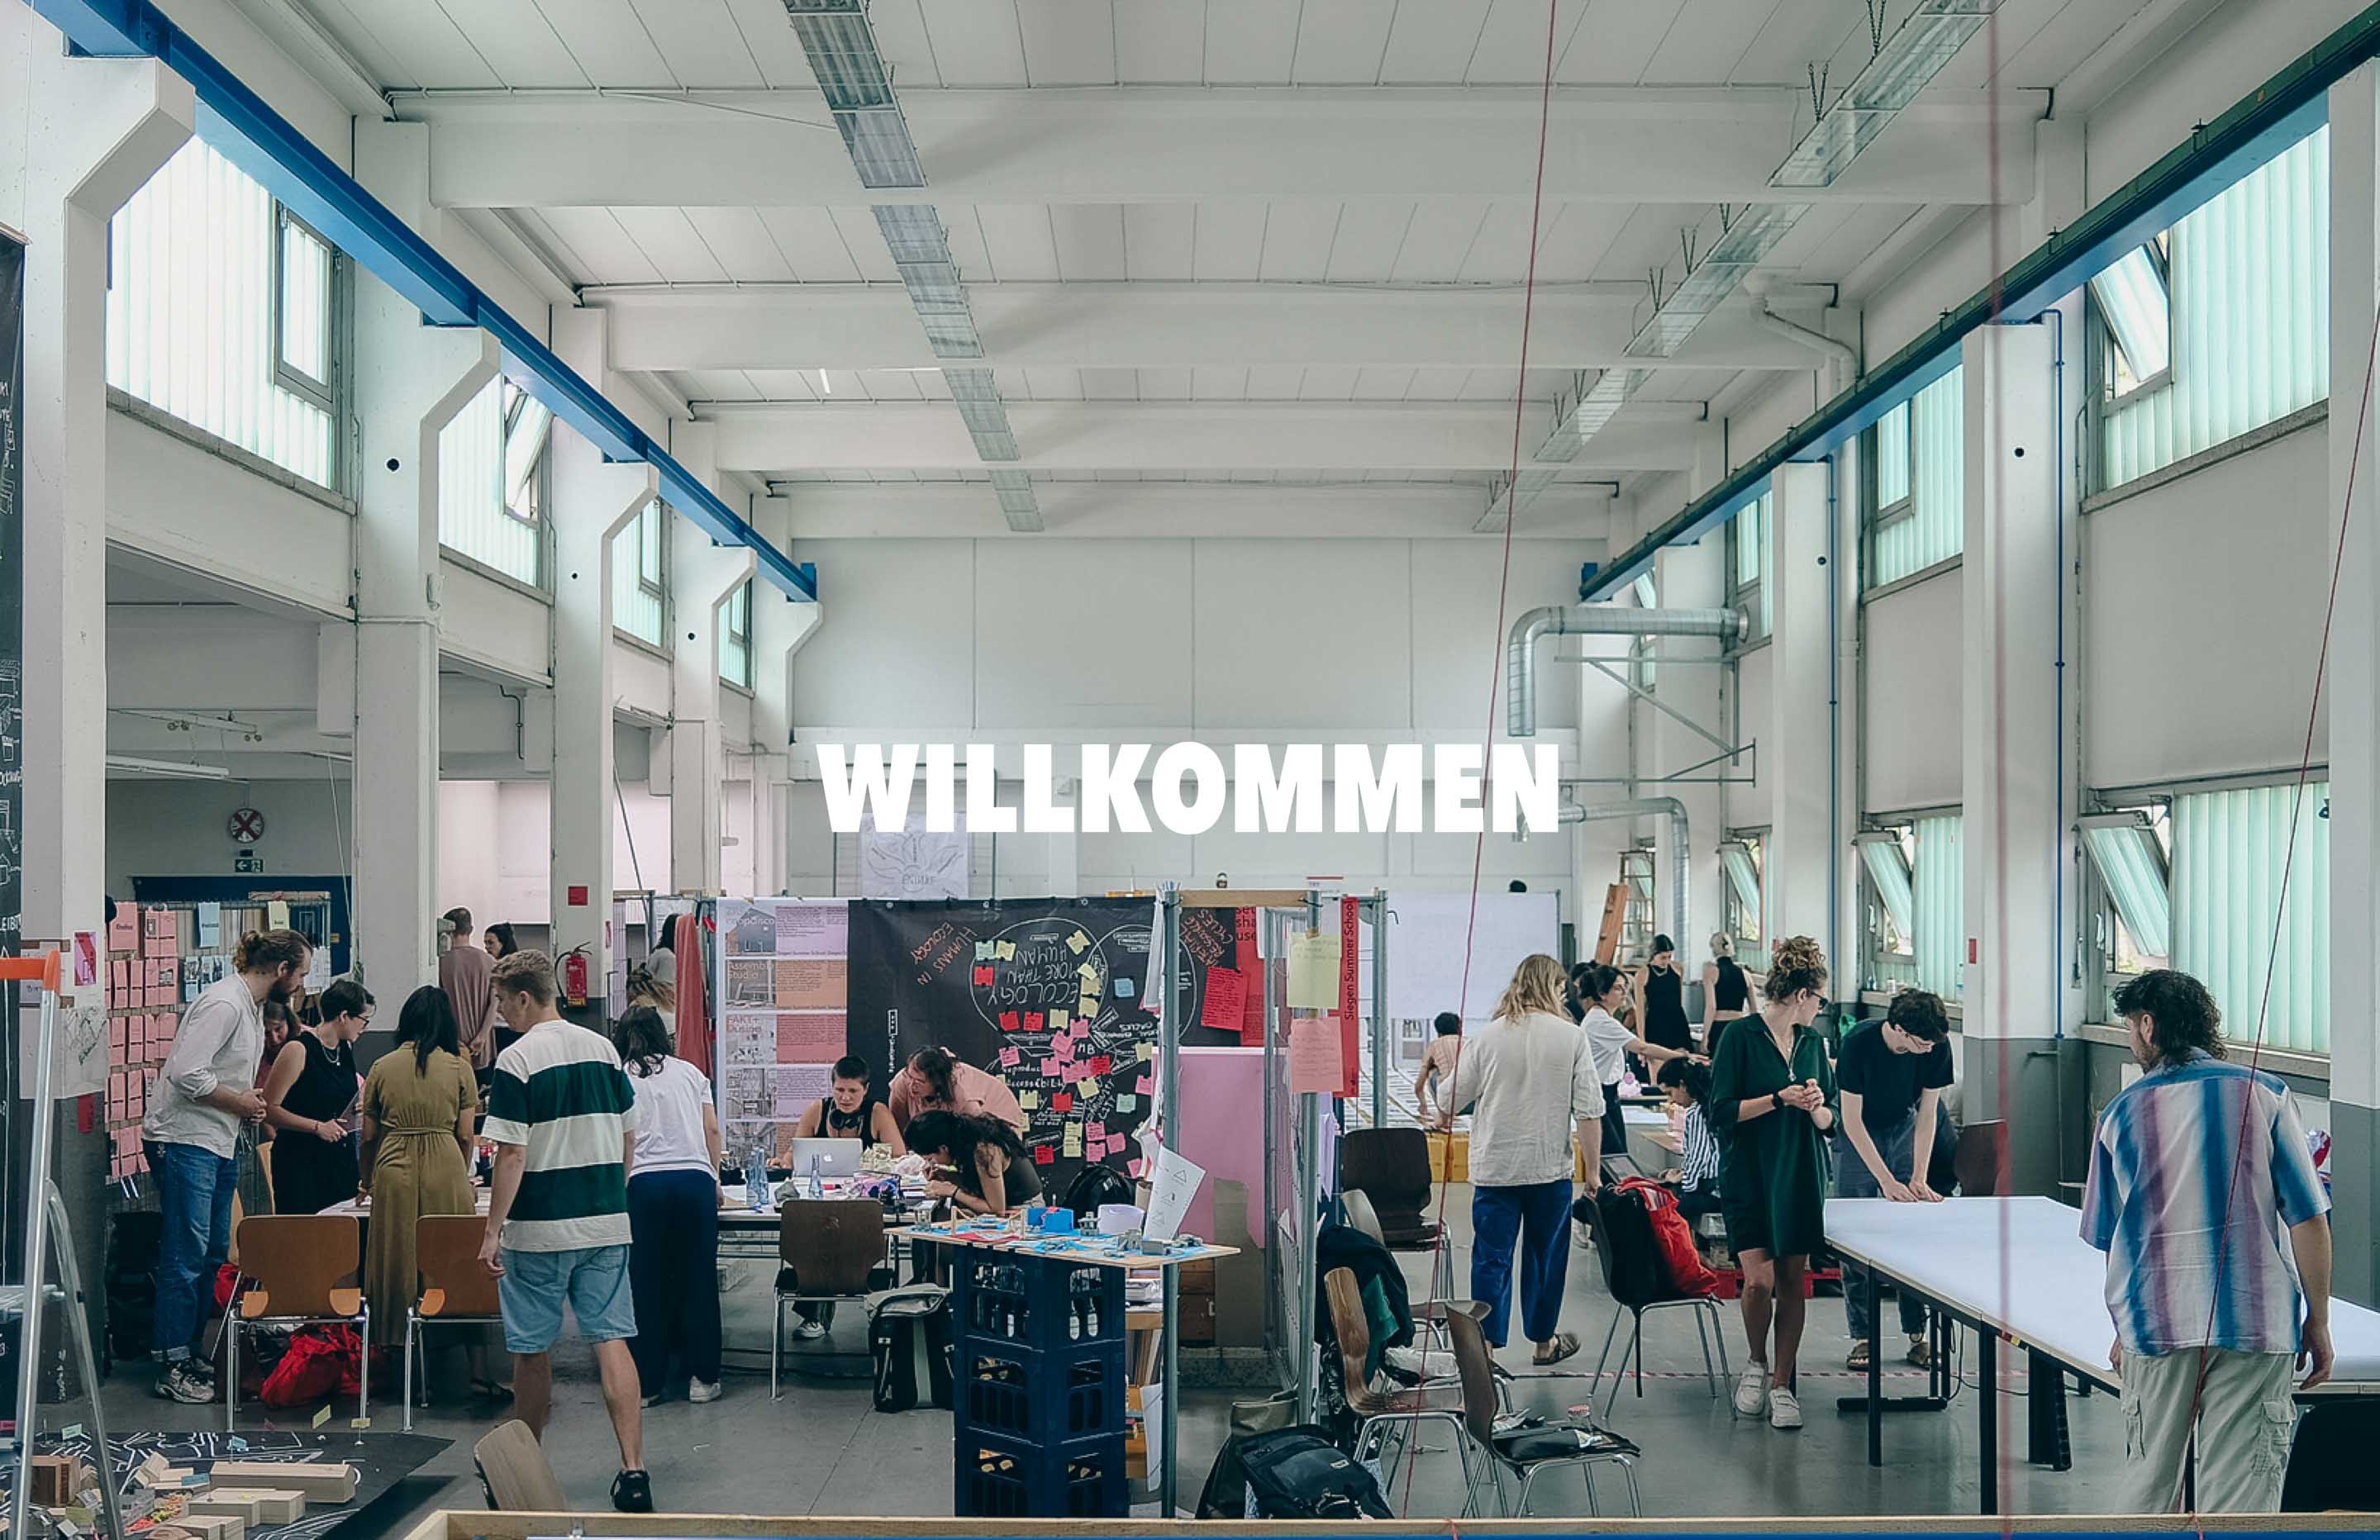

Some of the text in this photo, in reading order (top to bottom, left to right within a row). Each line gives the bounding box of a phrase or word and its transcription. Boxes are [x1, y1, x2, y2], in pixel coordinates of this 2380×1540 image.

[911, 921, 954, 964] ECOLOGY
[917, 926, 978, 985] HUMANS IN
[1016, 946, 1067, 965] HUMAN
[1007, 962, 1080, 984] MORE THAN
[1344, 900, 1356, 1020] Siegen Summer School
[988, 982, 1078, 1005] ECOLOGY
